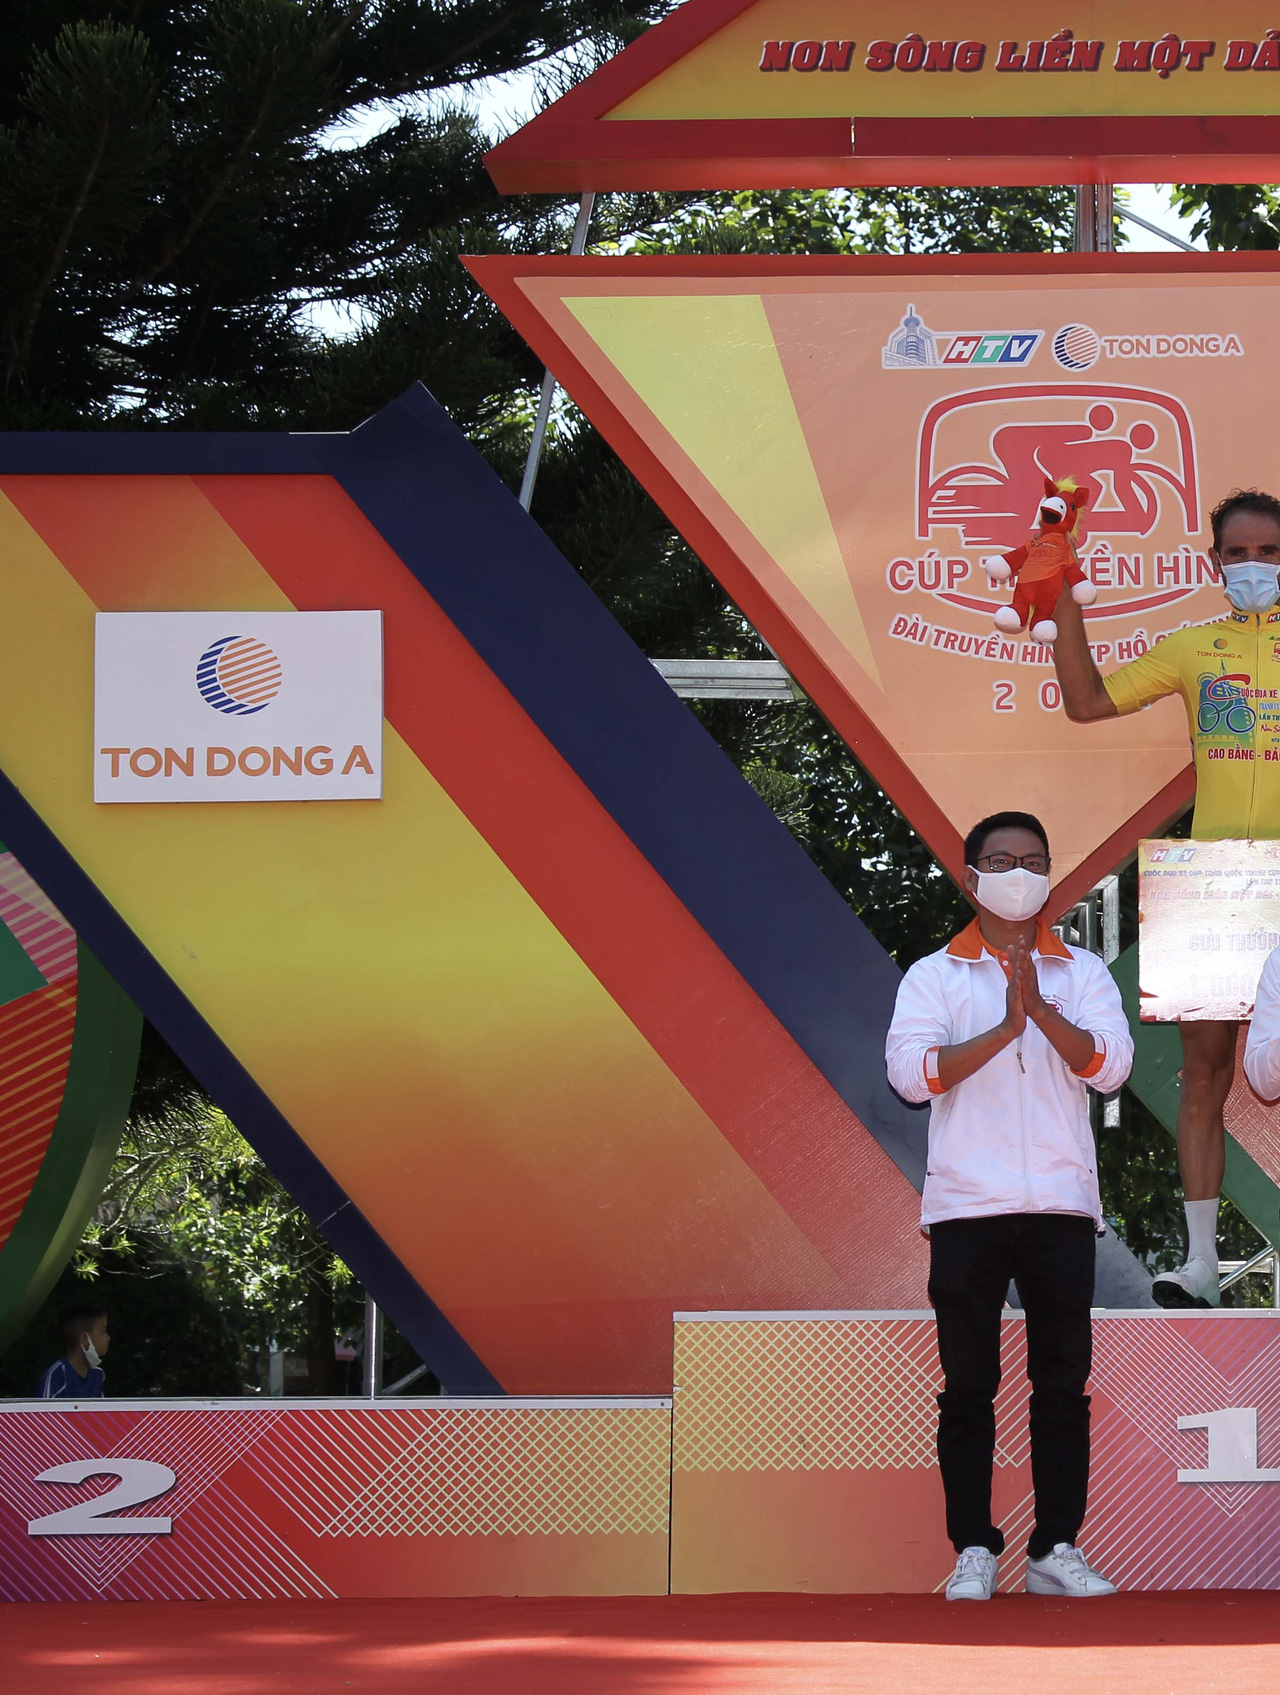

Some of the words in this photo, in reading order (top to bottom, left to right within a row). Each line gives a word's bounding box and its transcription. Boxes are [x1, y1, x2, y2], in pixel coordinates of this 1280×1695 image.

[759, 40, 855, 72] NON
[864, 33, 987, 72] SÔNG
[1113, 32, 1216, 79] MỘT
[946, 337, 1036, 361] HTV
[1103, 338, 1151, 355] TON
[1155, 337, 1222, 355] DONG
[1224, 336, 1241, 354] A
[889, 552, 969, 590] CÚP
[1157, 547, 1221, 585] HÌN
[892, 616, 929, 643] ĐÀI
[933, 628, 1015, 661] TRUYỀN
[1022, 641, 1056, 664] HÌN
[1117, 630, 1148, 660] HỒ
[1269, 689, 1278, 699] XE
[100, 747, 195, 778] TON
[206, 745, 334, 777] DONG
[341, 745, 375, 775] A
[1208, 748, 1225, 760] CAO
[1228, 743, 1255, 761] BẰNG
[1150, 848, 1198, 863] HTV
[27, 1457, 177, 1536] 2
